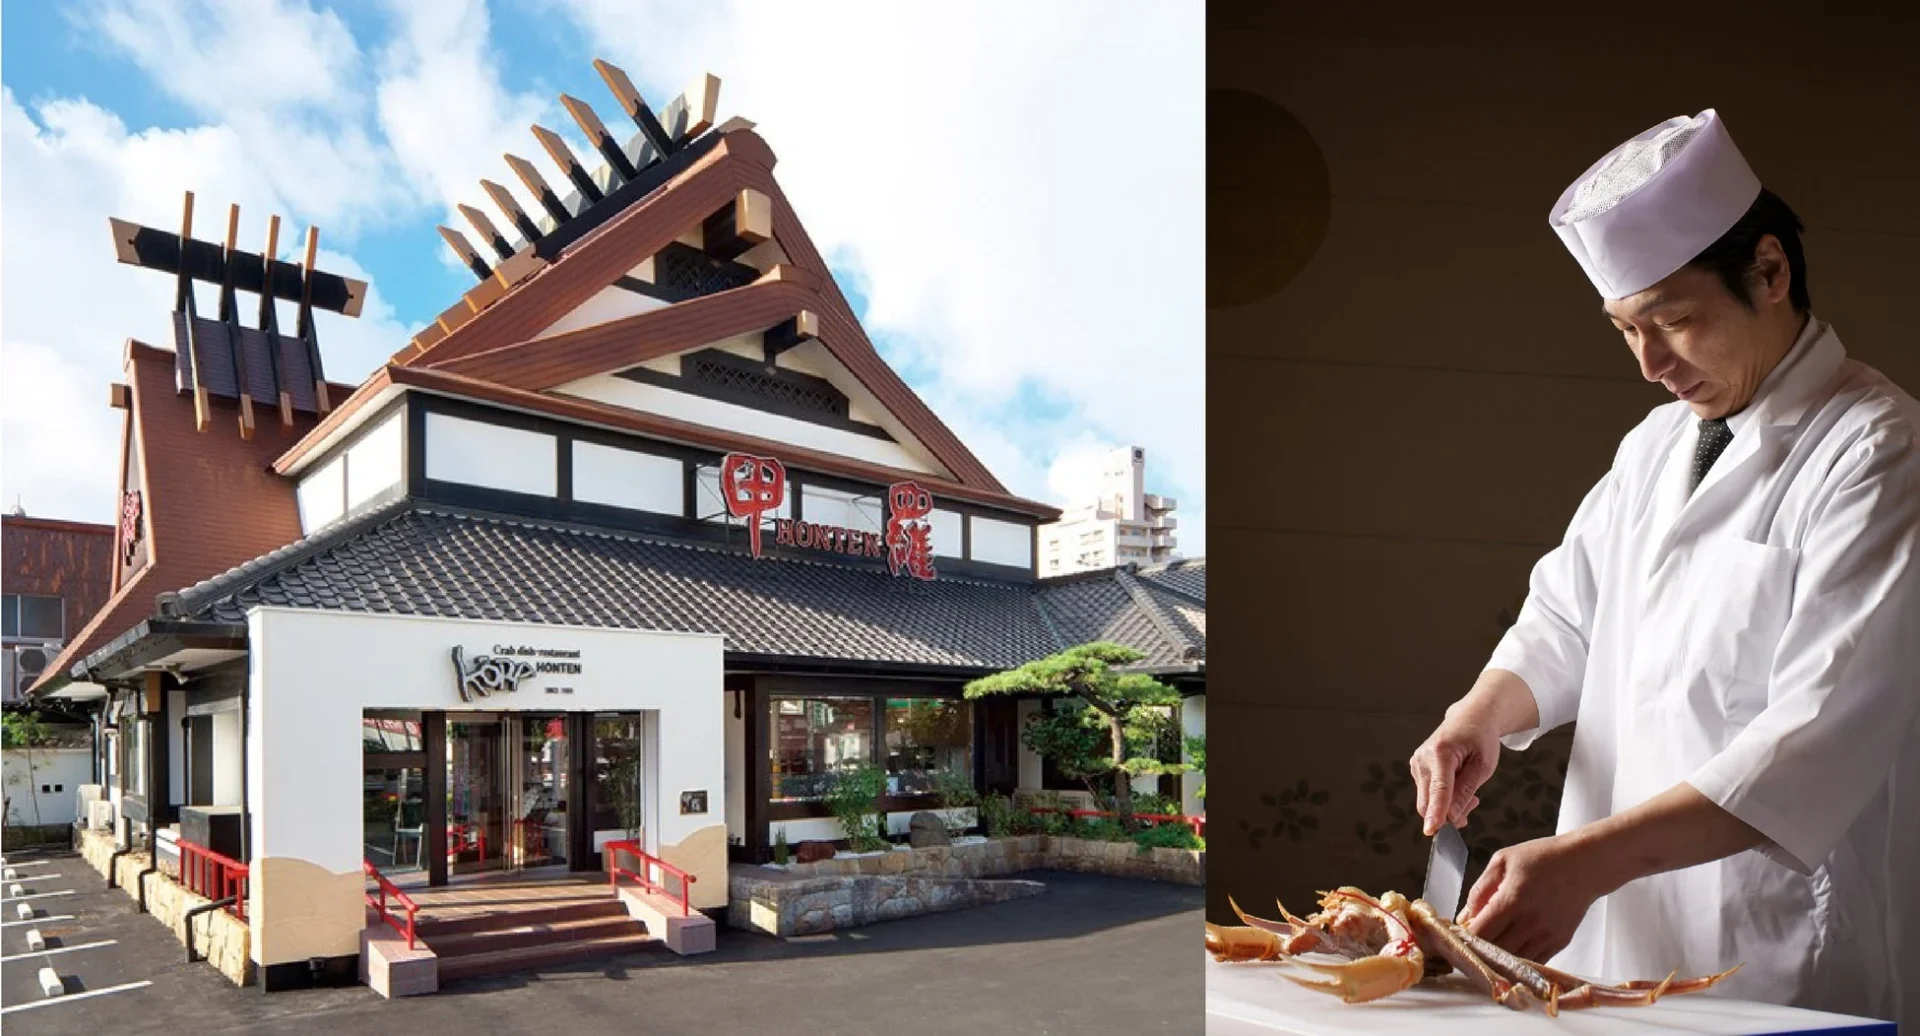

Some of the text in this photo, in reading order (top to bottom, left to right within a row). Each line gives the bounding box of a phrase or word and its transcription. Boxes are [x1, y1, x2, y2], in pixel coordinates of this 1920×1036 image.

[721, 453, 785, 559] 甲
[776, 519, 880, 556] HONTEN
[493, 644, 516, 655] Crab
[536, 662, 582, 674] HONTEN
